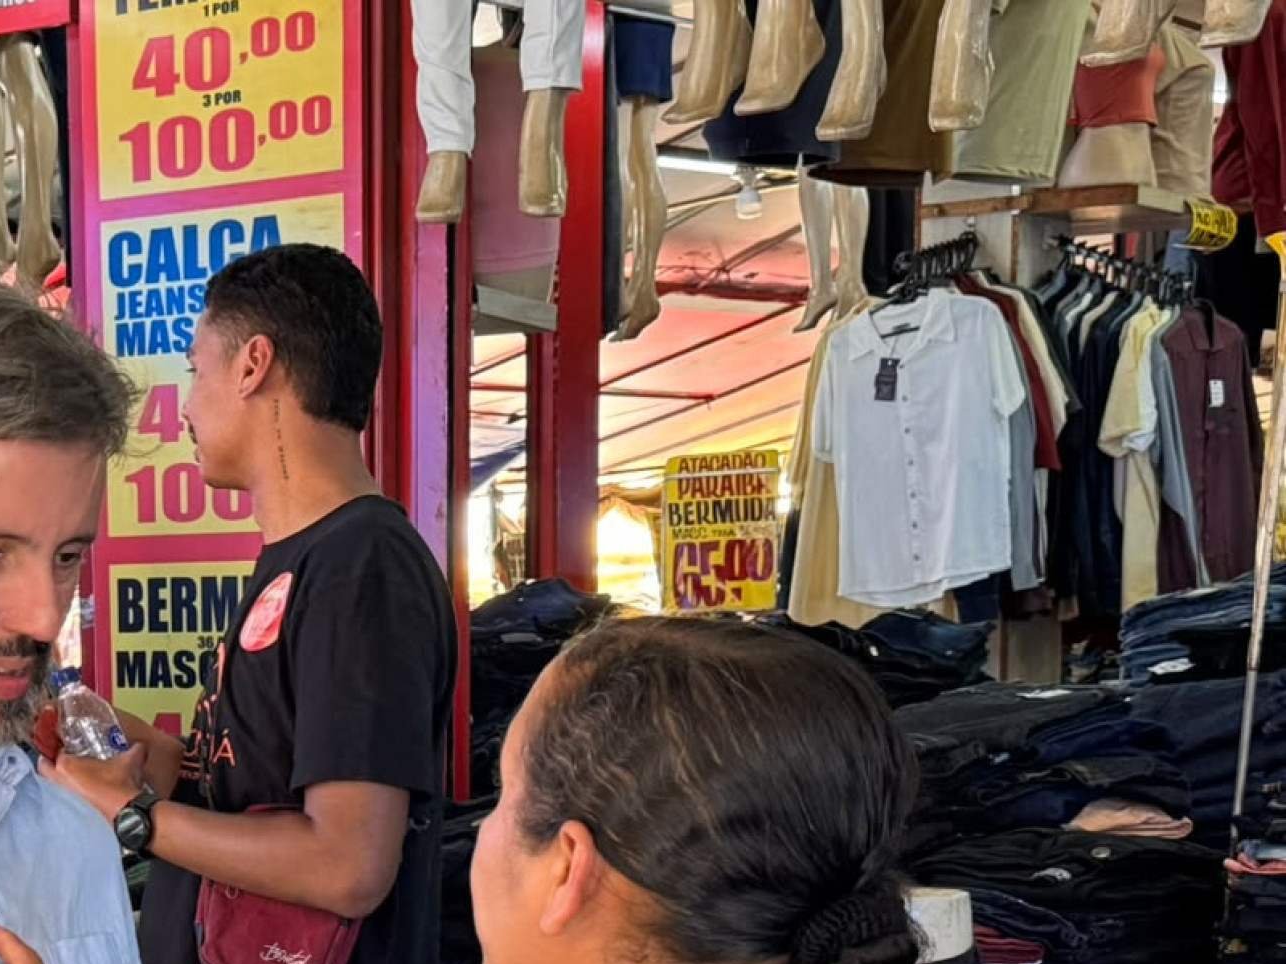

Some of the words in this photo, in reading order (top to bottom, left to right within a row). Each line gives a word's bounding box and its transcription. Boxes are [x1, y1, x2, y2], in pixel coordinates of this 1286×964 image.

[203, 4, 210, 17] 1
[213, 1, 239, 16] POR
[203, 94, 212, 108] 3
[214, 90, 242, 106] POR
[119, 94, 333, 183] 100,00
[115, 283, 206, 321] JEANS
[668, 497, 776, 527] BERMUDA
[197, 636, 214, 650] 36
